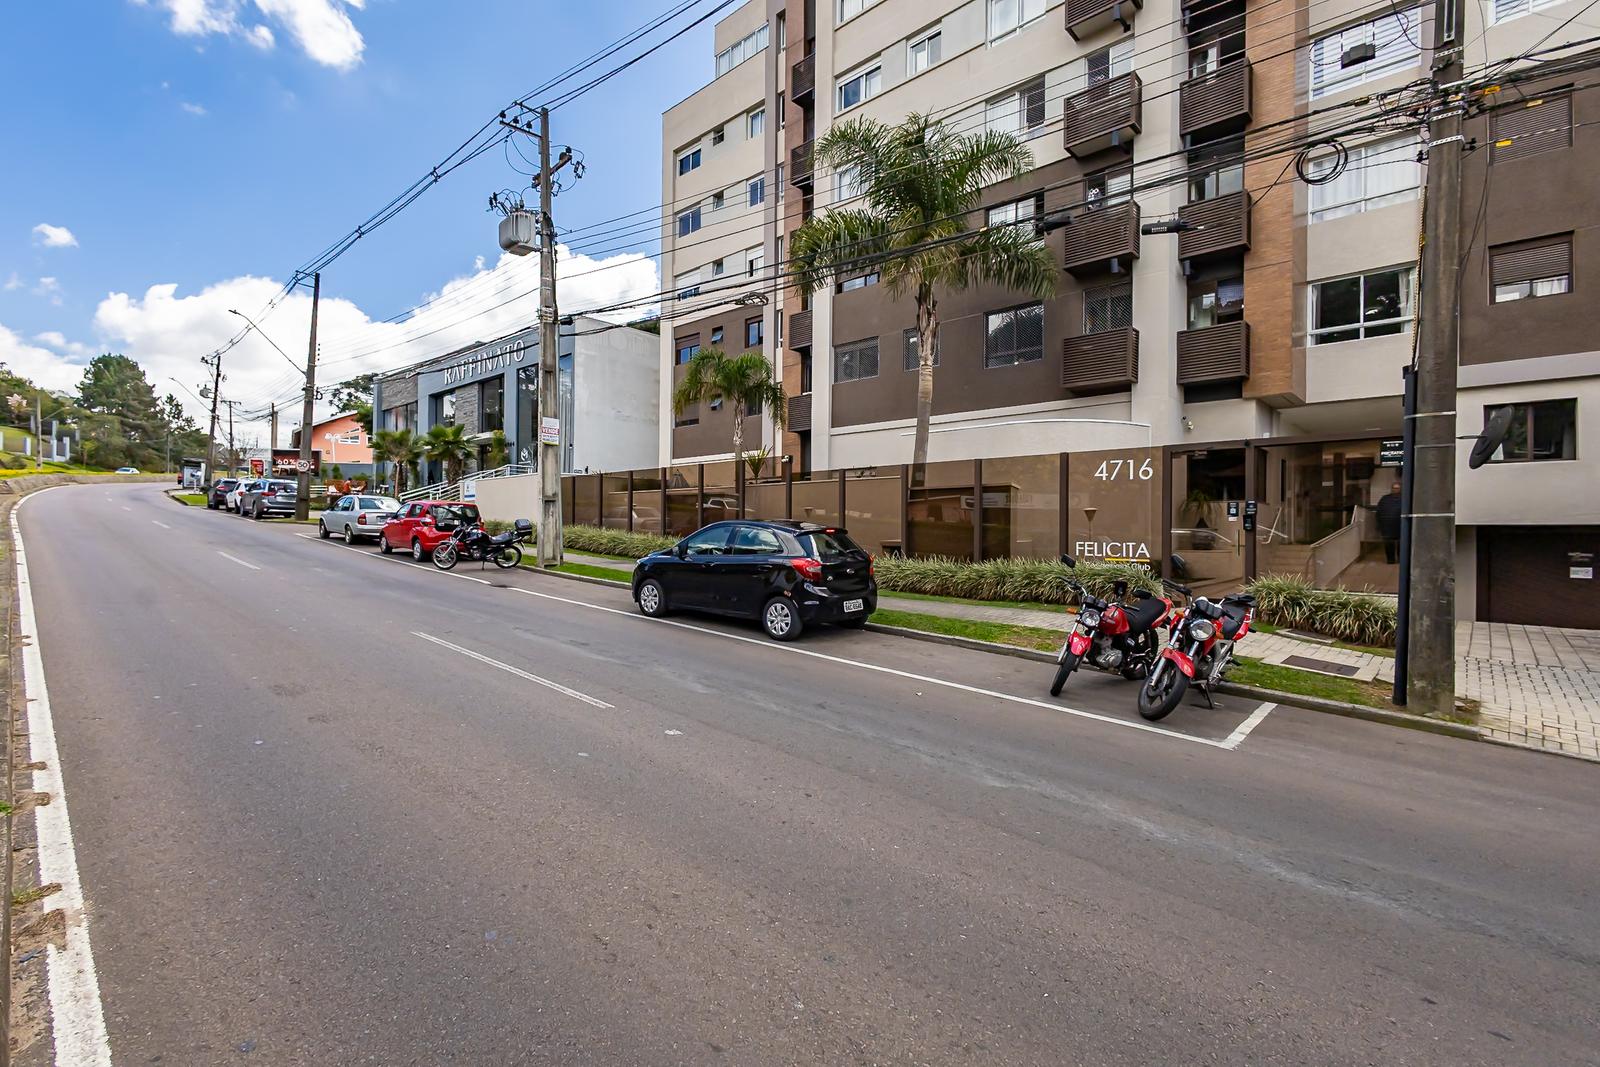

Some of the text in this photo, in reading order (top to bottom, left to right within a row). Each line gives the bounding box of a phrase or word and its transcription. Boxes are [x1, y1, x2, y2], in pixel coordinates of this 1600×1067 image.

[444, 340, 525, 385] RAFFINATO
[1094, 458, 1153, 480] 4716
[1075, 541, 1151, 558] FELICITA
[1131, 563, 1151, 571] Club
